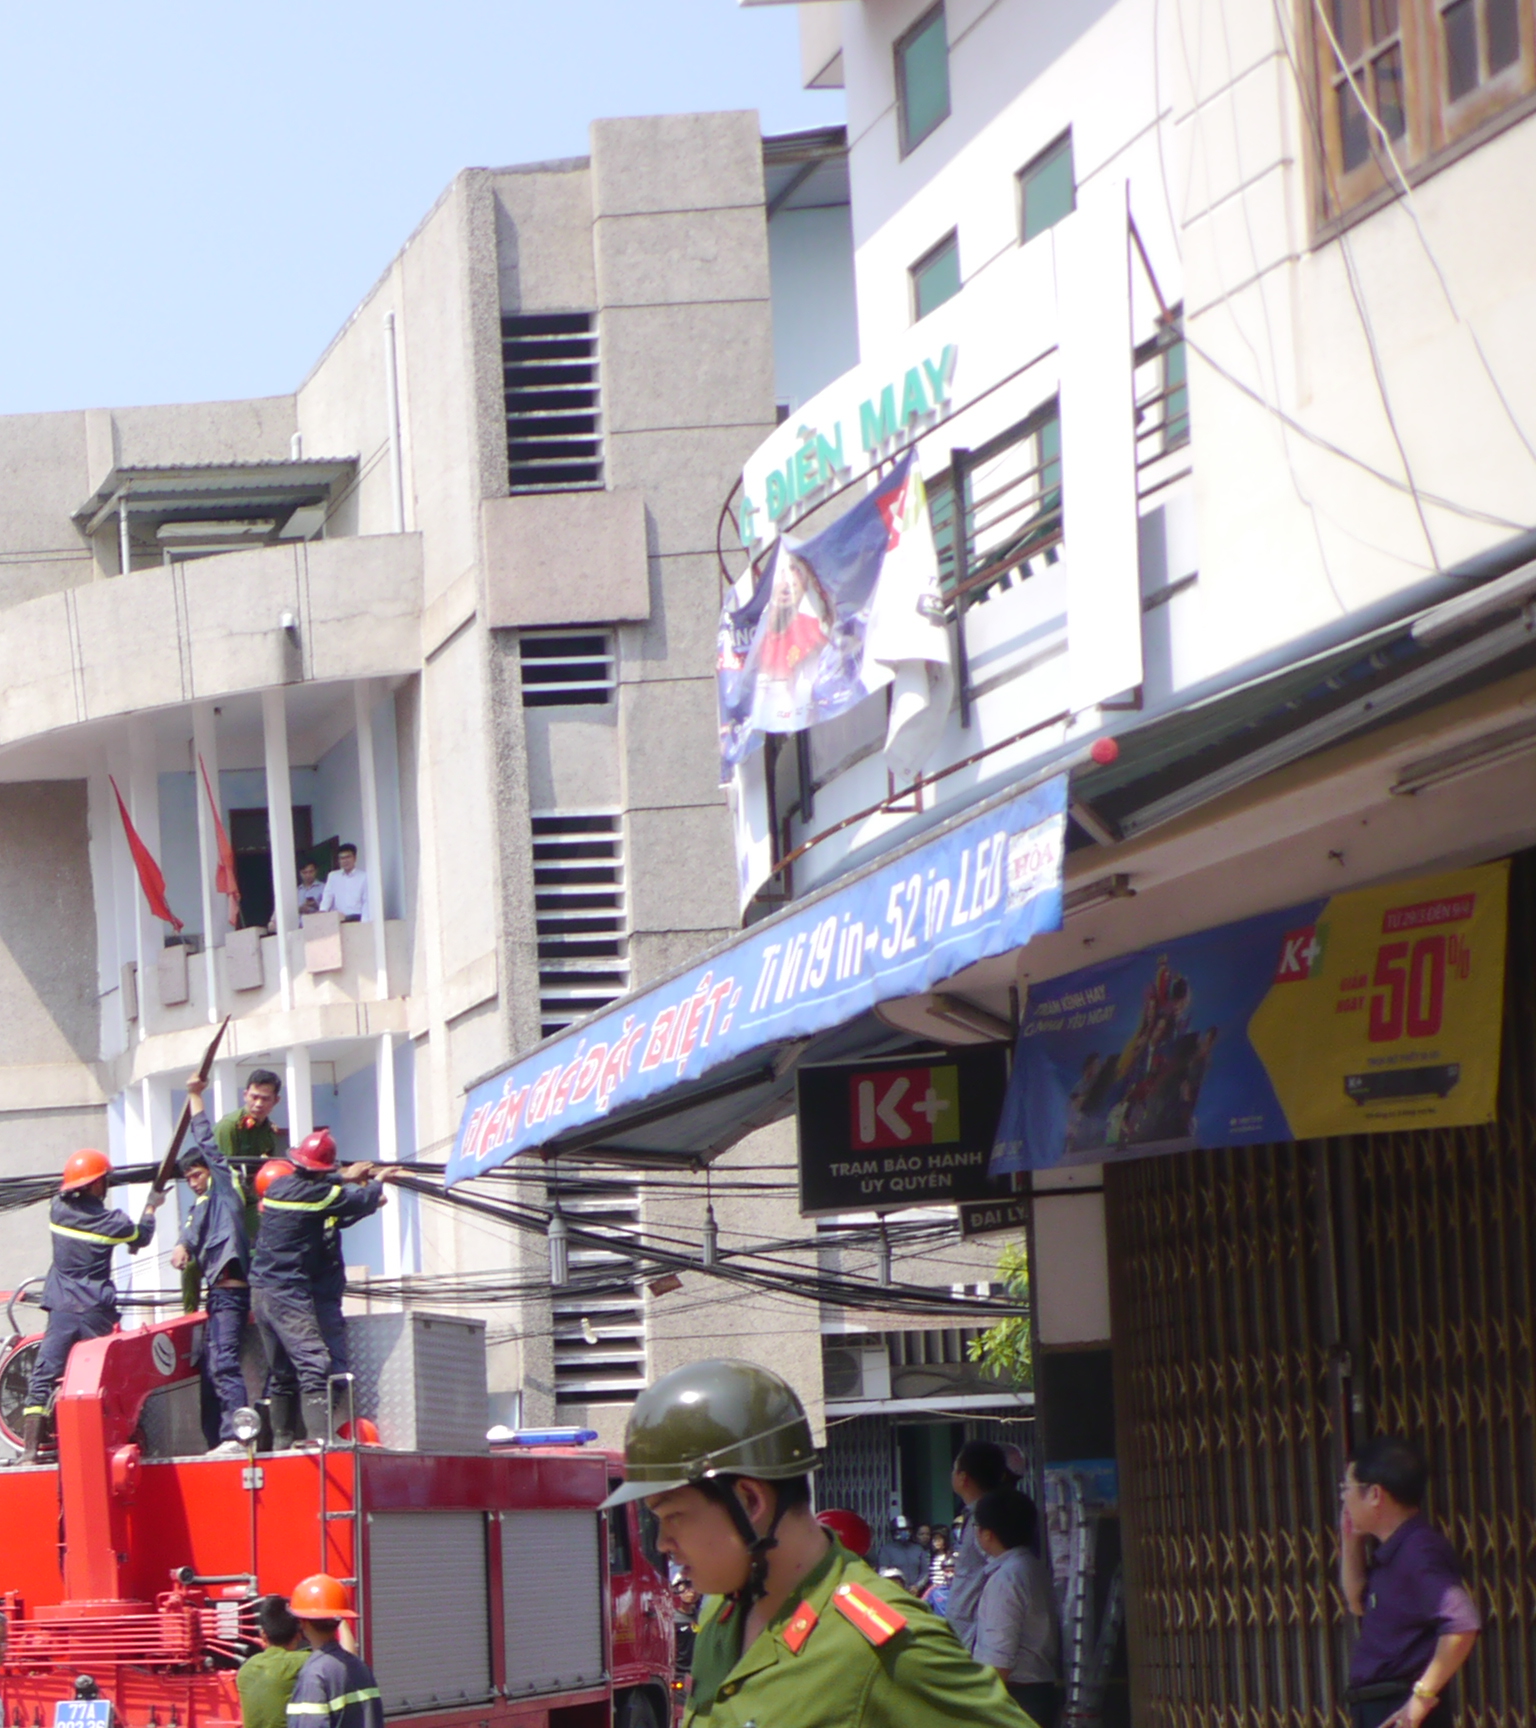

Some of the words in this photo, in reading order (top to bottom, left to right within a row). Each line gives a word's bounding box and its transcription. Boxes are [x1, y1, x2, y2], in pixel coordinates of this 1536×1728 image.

[882, 873, 922, 960] 52
[1280, 936, 1322, 973] K+
[858, 1076, 950, 1143] K+
[830, 1161, 879, 1178] TRẠM
[883, 1154, 922, 1173] BẢO
[69, 1703, 95, 1720] 77A
